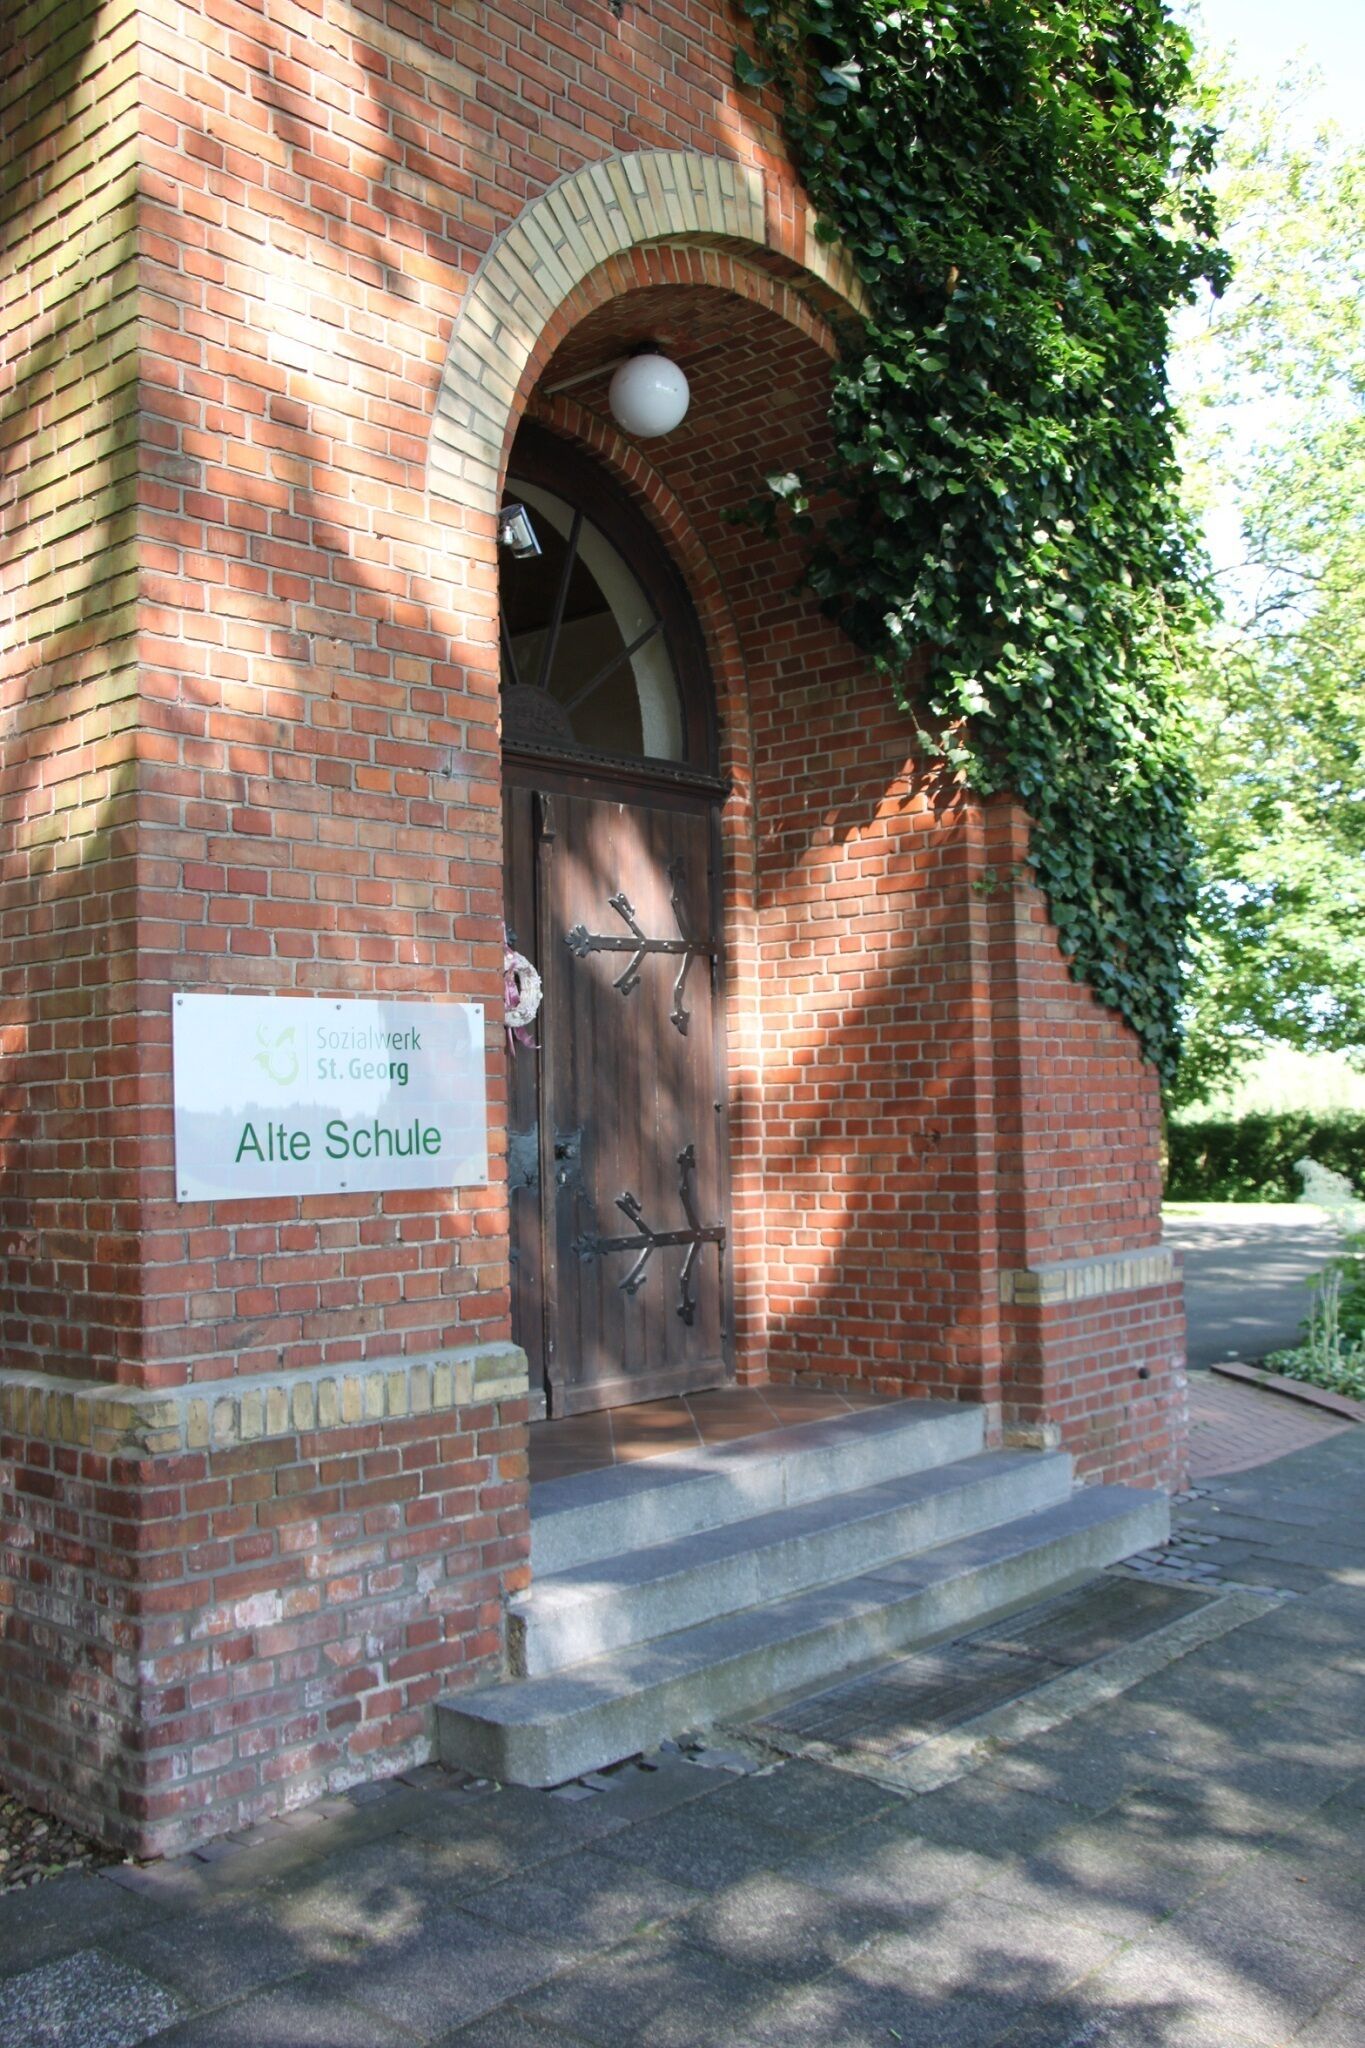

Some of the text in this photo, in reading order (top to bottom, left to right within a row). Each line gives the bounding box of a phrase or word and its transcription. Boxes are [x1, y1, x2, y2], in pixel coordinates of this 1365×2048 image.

[317, 1026, 422, 1051] Sozialwerk
[317, 1058, 409, 1086] St. Georg
[235, 1119, 442, 1163] Alte Schule
